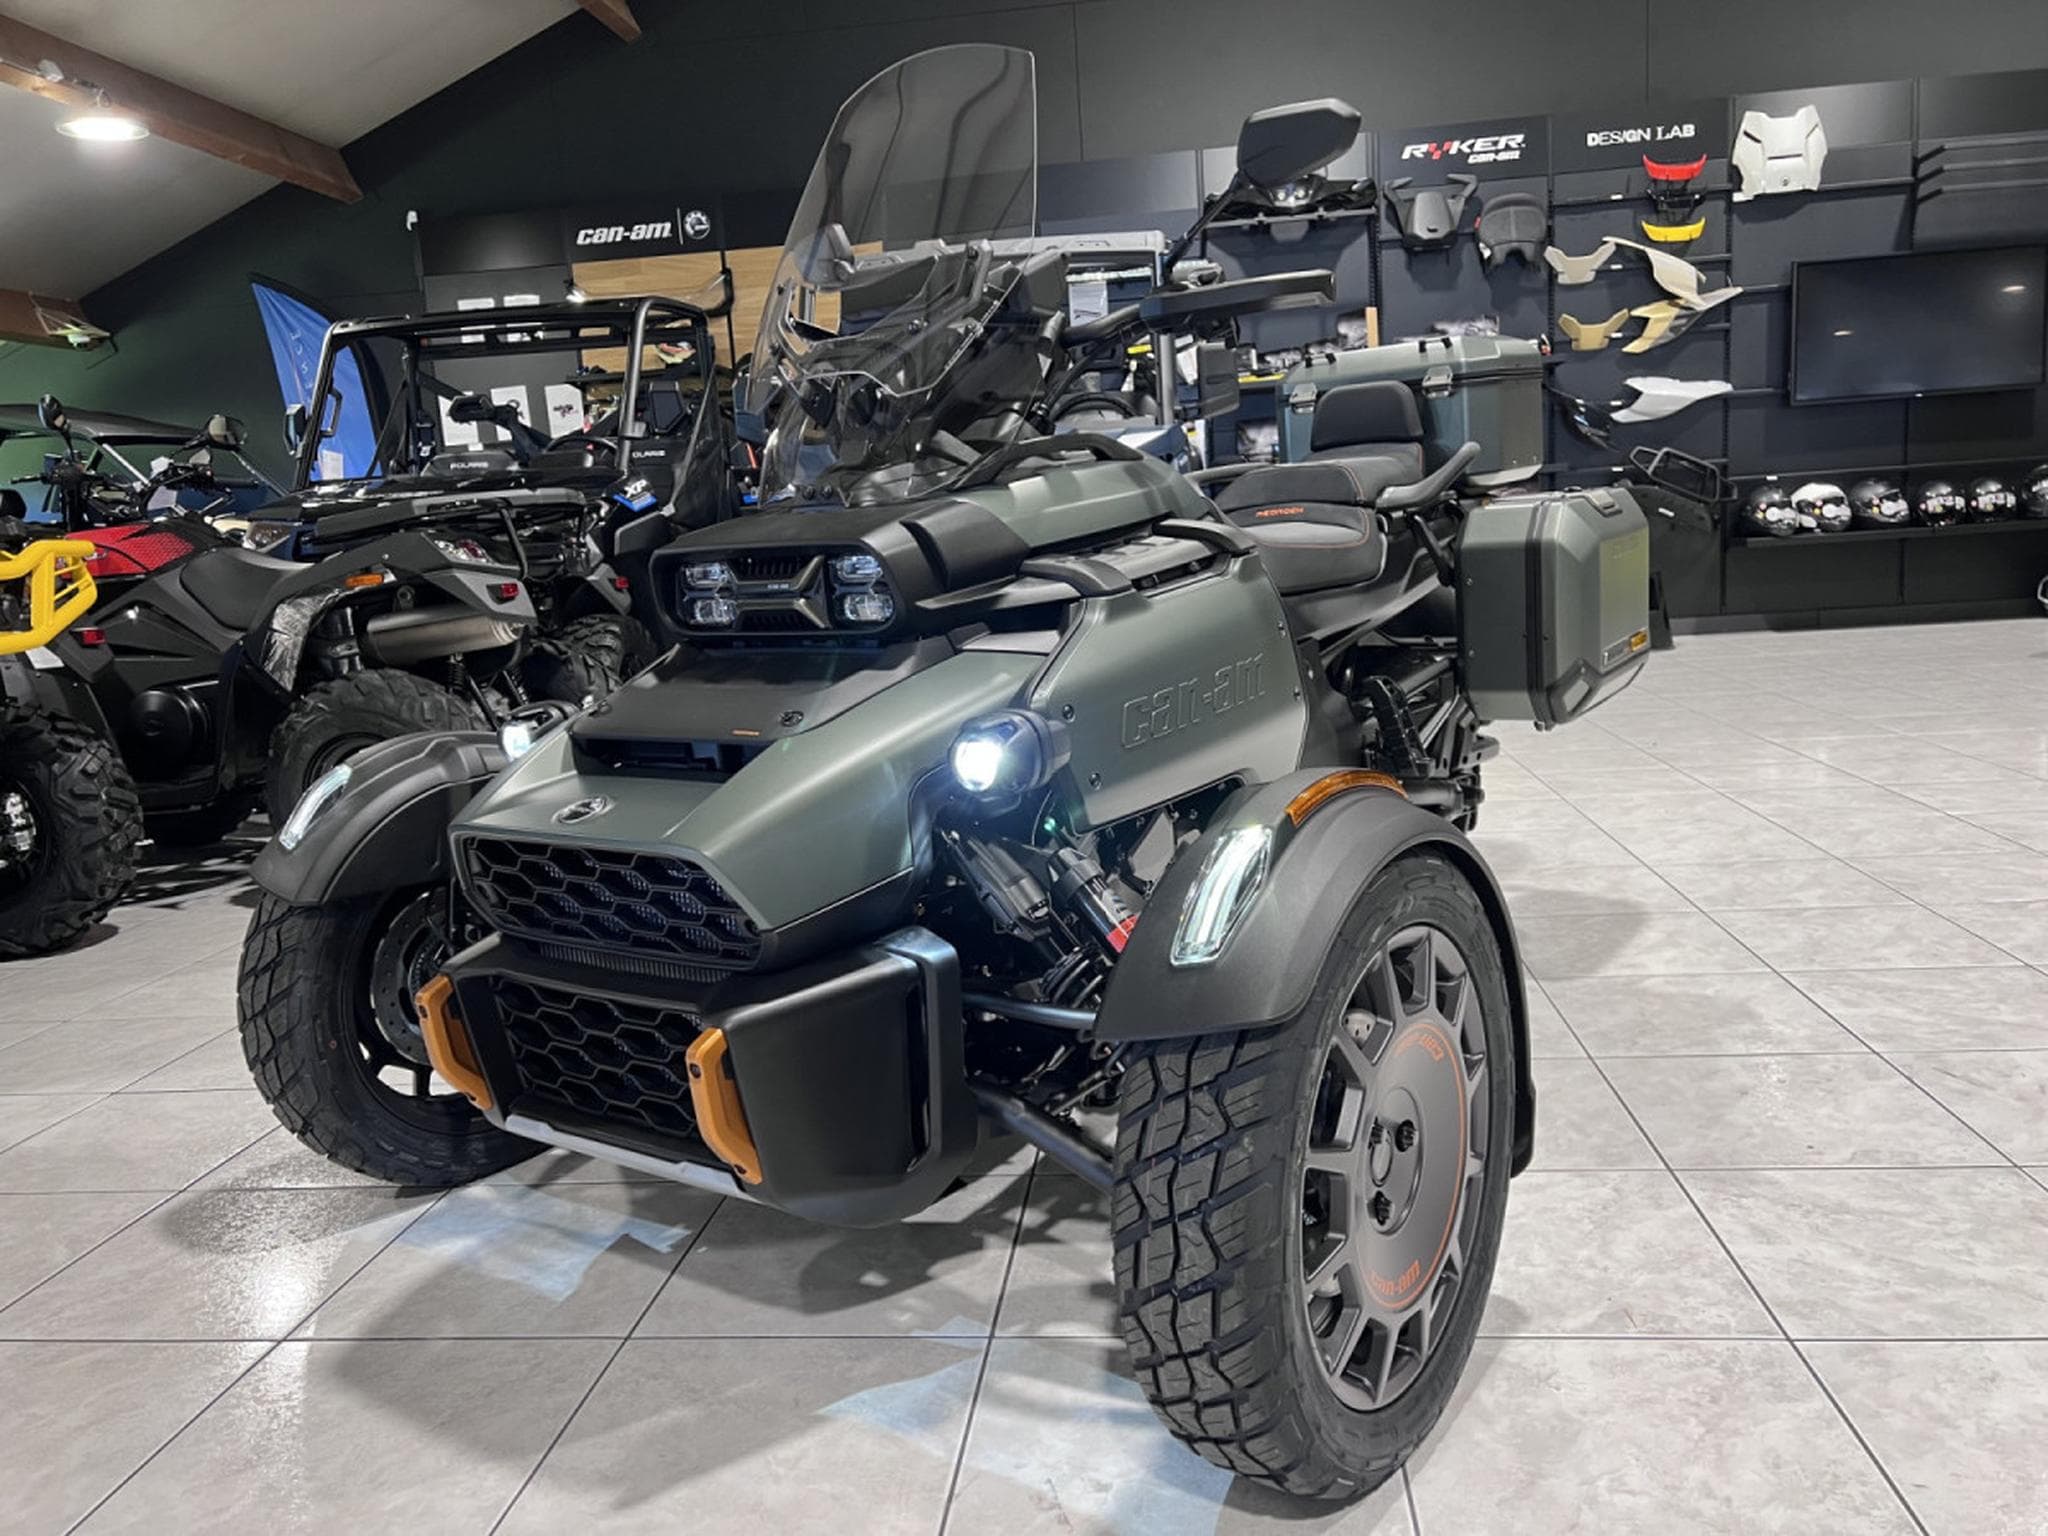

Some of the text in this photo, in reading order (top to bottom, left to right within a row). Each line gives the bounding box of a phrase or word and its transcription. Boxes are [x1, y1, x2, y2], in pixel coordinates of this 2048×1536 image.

[1400, 133, 1526, 161] RYKER
[1586, 123, 1696, 147] DESIGN LAB
[575, 221, 673, 246] can-am
[631, 449, 666, 459] OLARIS
[623, 478, 648, 499] XP
[1120, 652, 1267, 750] can-am
